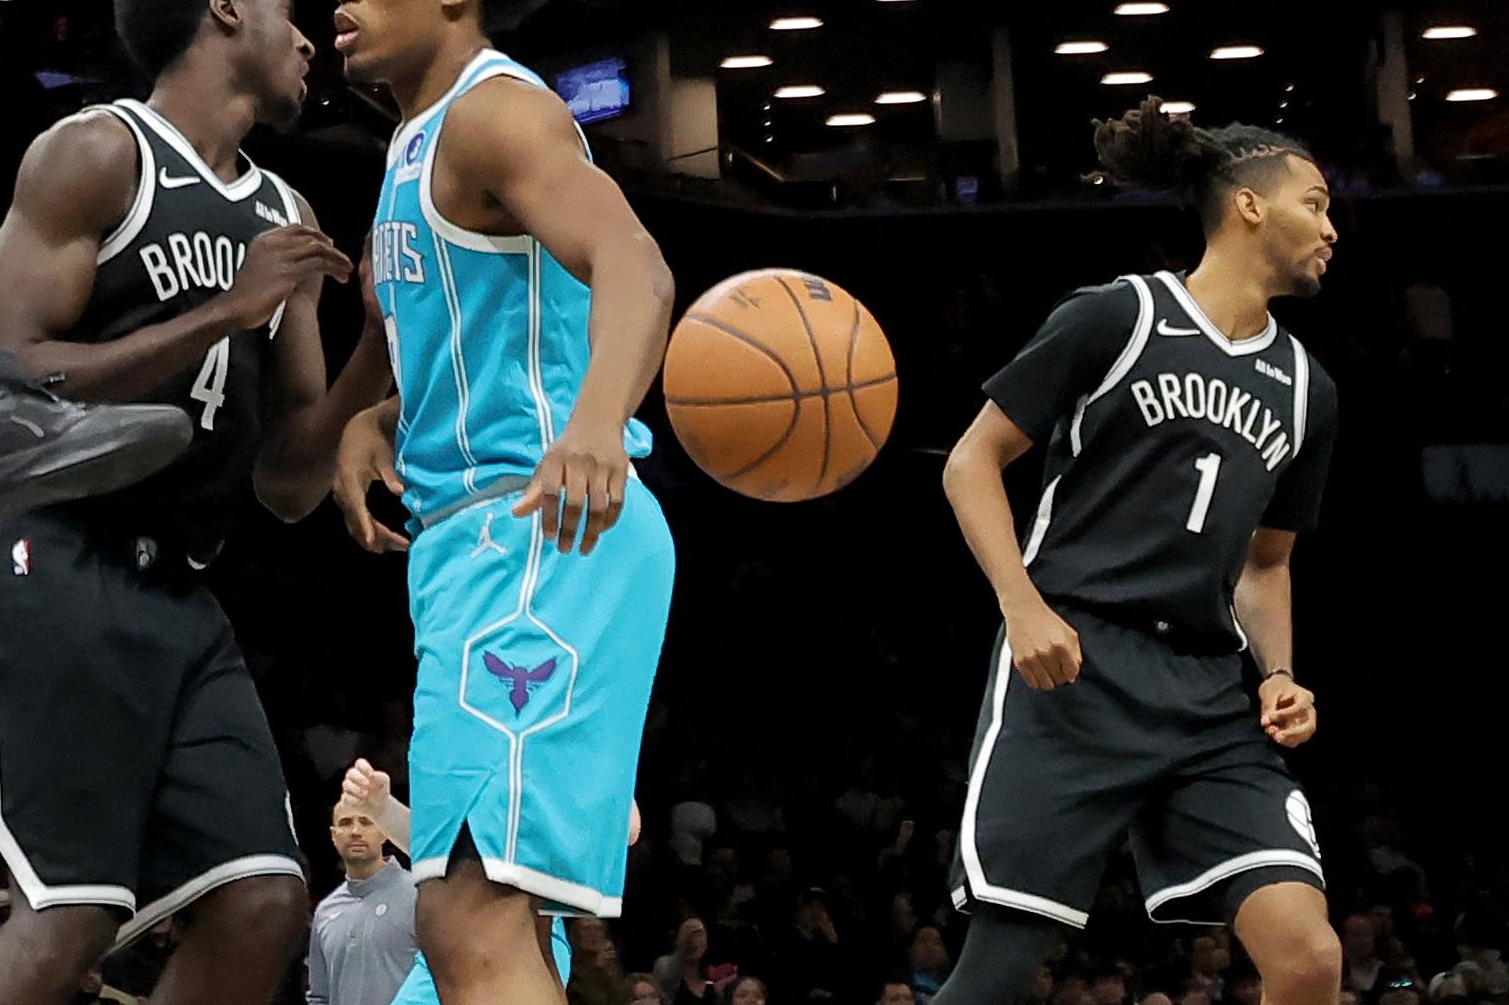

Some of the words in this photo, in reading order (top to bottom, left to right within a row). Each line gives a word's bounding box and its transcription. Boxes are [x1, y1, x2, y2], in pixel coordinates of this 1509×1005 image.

[190, 335, 230, 431] 4
[1130, 372, 1291, 472] BROOKLYN
[1186, 452, 1222, 534] 1
